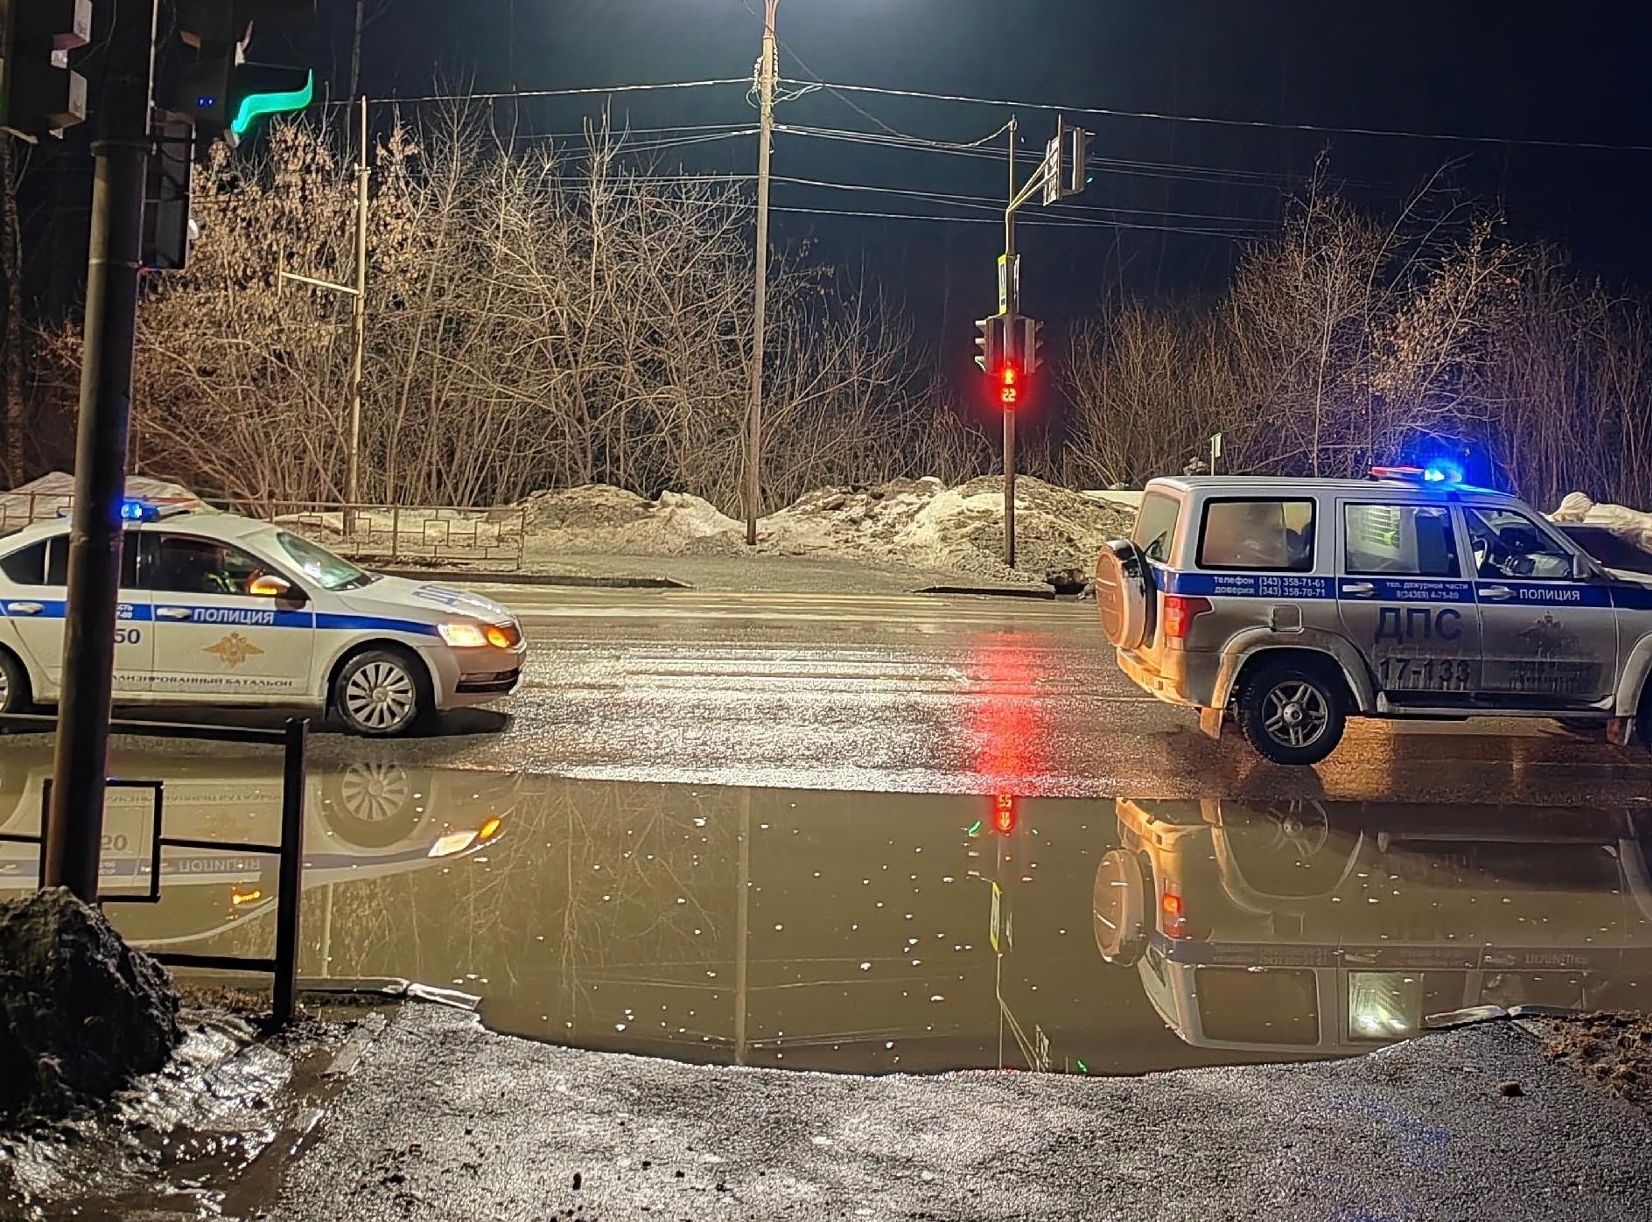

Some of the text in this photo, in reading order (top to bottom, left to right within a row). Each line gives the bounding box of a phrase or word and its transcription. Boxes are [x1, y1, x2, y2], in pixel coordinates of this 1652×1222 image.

[1213, 576, 1255, 586] телефон
[1259, 576, 1281, 587] (343)
[1214, 586, 1255, 595] доверия
[1259, 586, 1281, 597] (343)
[1519, 588, 1581, 601] ПОЛИЦИЯ
[193, 607, 275, 625] ПОЛИЦИЯ
[1374, 607, 1462, 644] ДПС
[226, 678, 293, 688] БАТАЛЬОН
